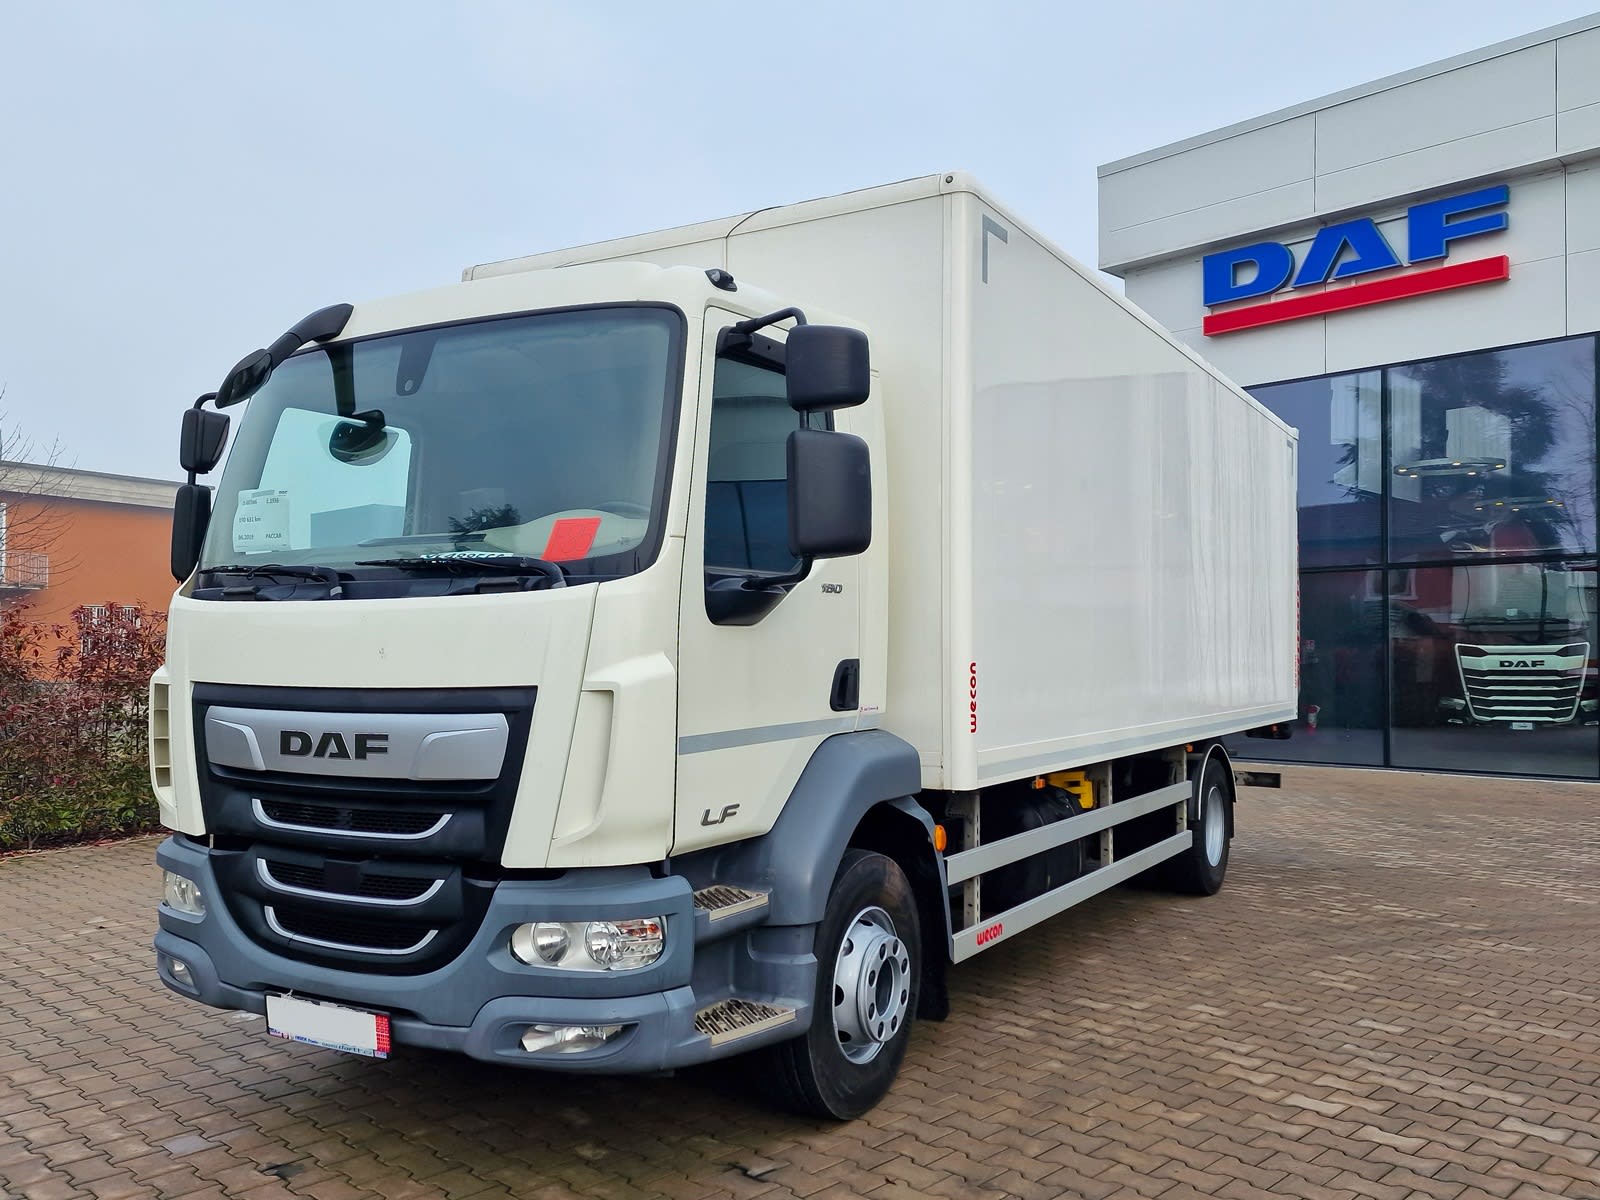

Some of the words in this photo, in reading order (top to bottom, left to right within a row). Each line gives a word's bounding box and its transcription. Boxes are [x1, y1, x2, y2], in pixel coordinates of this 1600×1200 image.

[1203, 184, 1509, 307] DAF
[821, 583, 843, 594] 180
[1499, 660, 1545, 668] DAF
[969, 662, 977, 733] wecon
[279, 730, 389, 760] DAF
[701, 804, 740, 826] LF
[976, 923, 1003, 945] wecon
